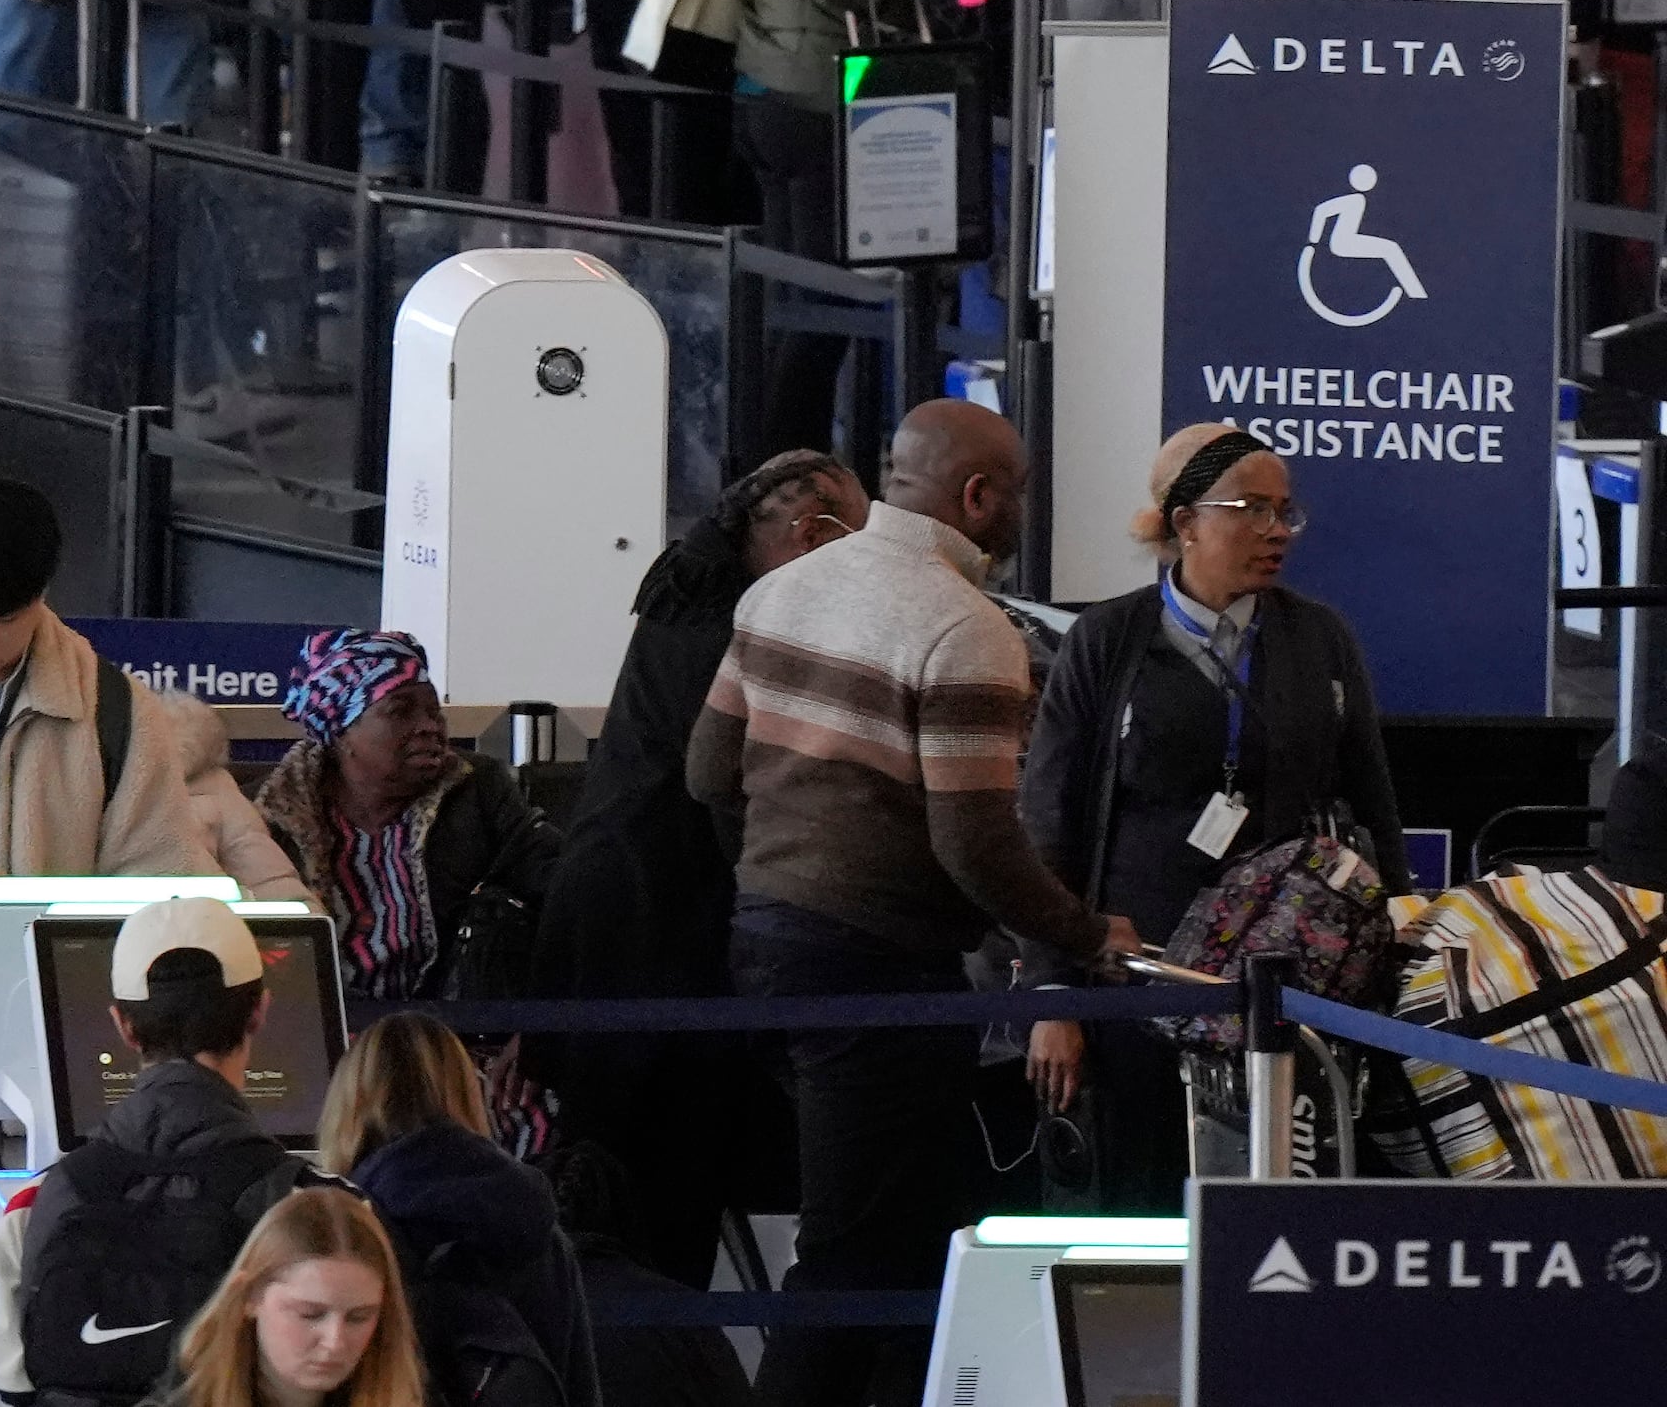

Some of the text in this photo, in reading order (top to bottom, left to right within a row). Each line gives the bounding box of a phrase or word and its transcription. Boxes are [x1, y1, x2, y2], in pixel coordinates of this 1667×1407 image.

[1274, 37, 1465, 76] DELTA
[1202, 365, 1515, 413] WHEELCHAIR
[402, 542, 437, 569] CLEAR
[188, 663, 278, 698] Here
[1334, 1239, 1583, 1289] DELTA
